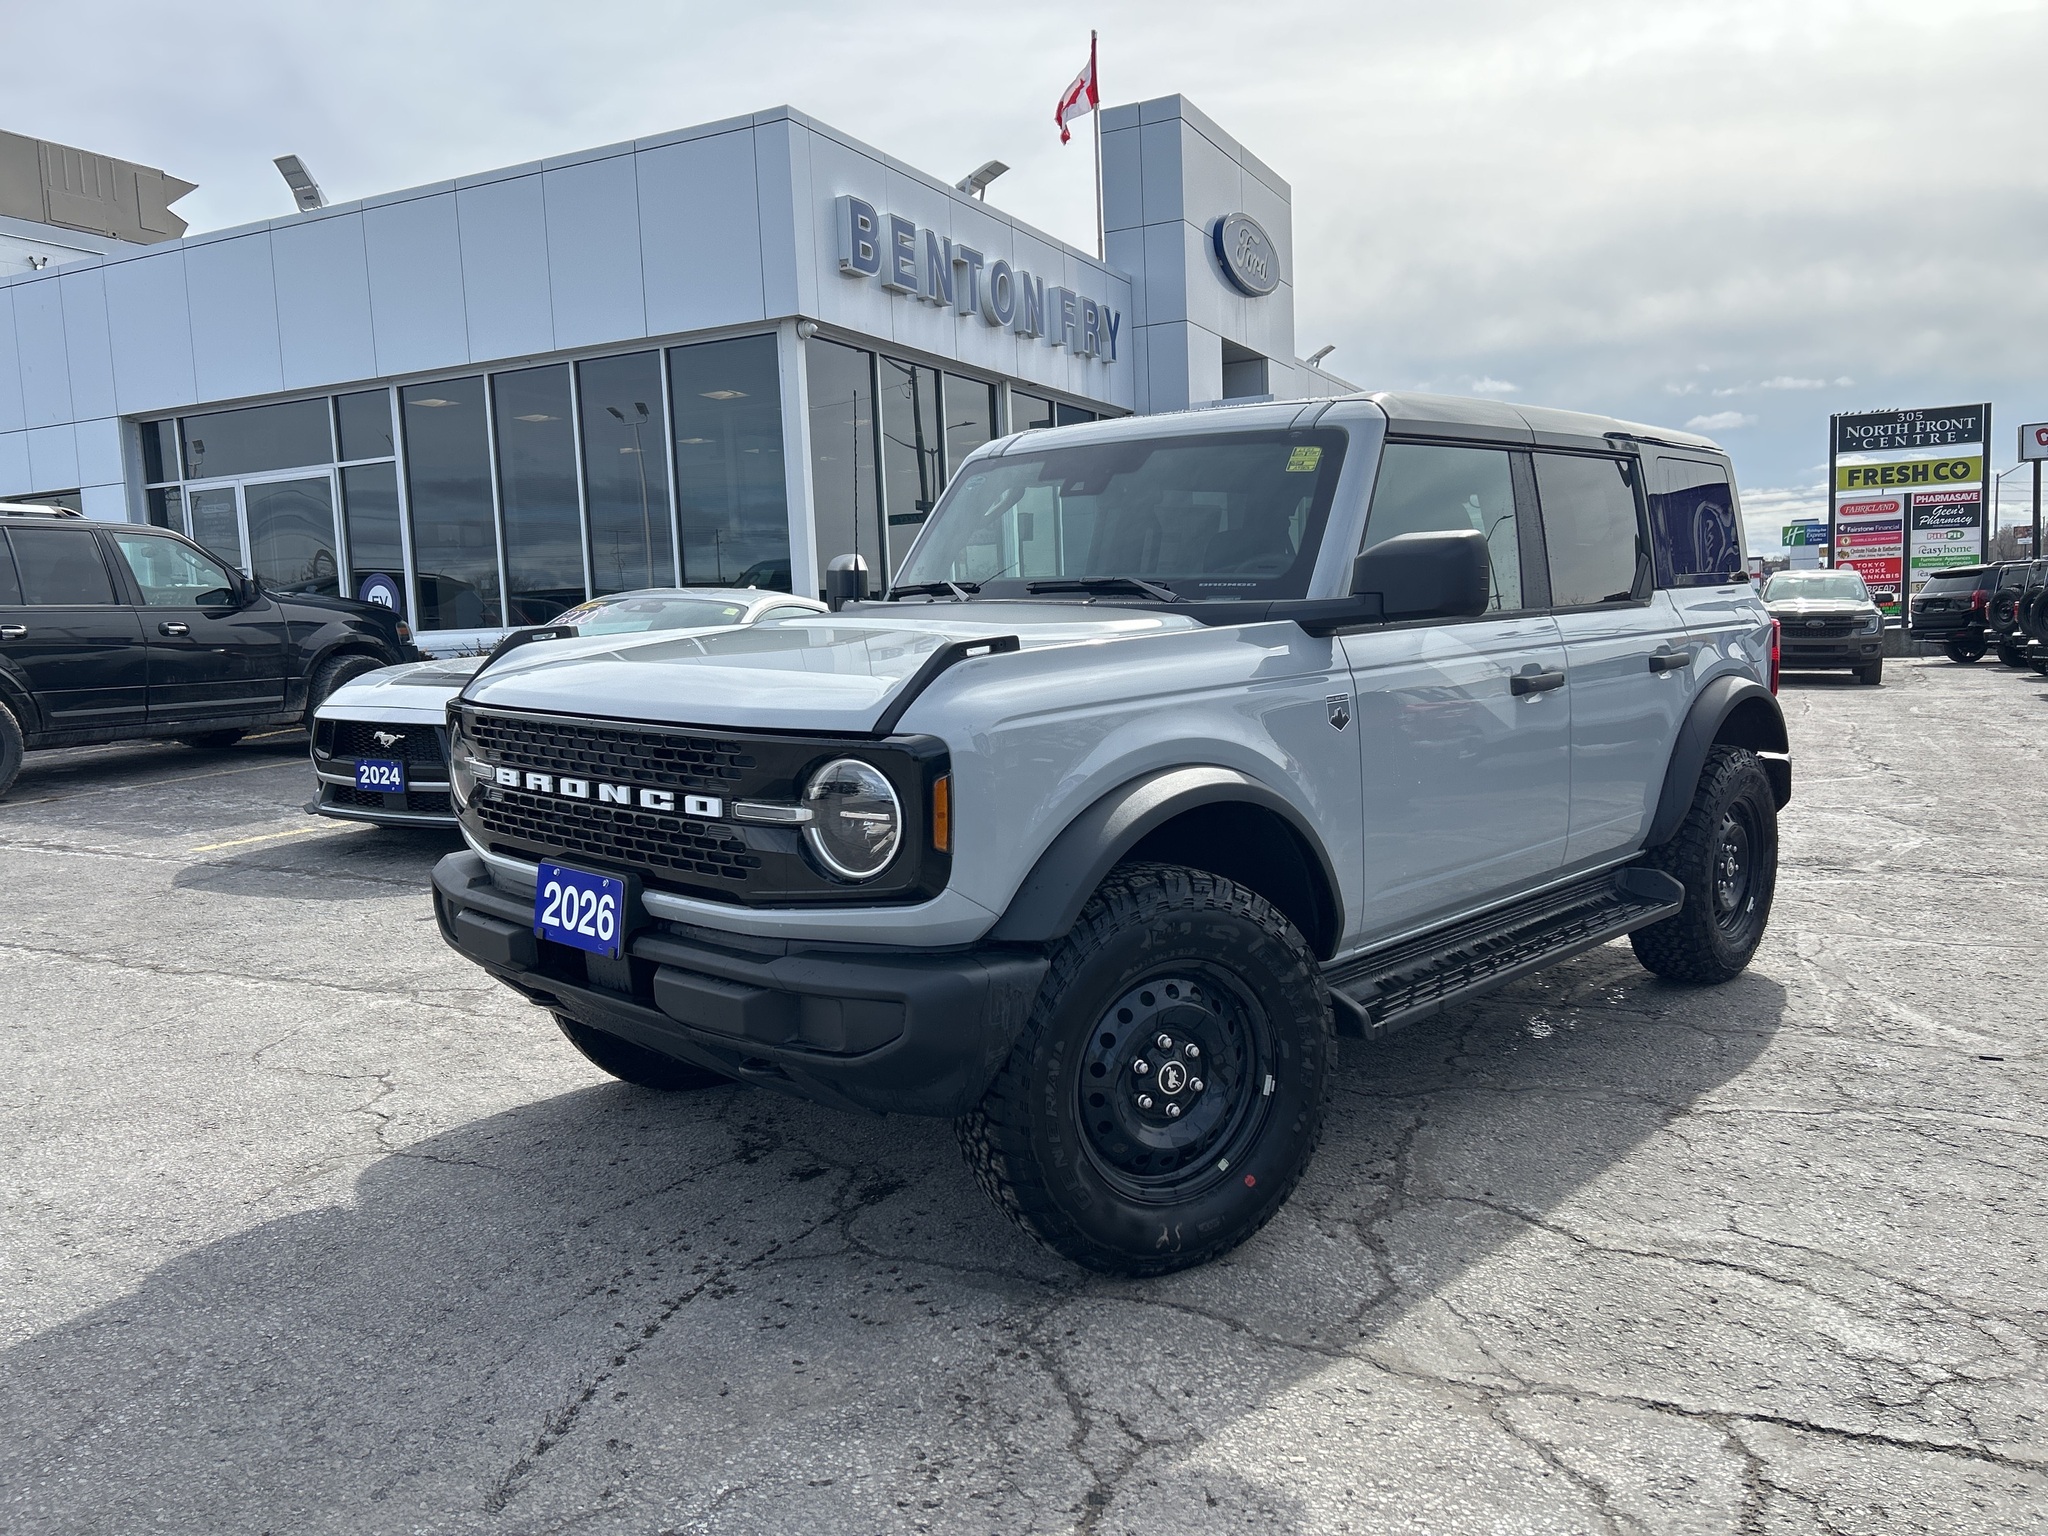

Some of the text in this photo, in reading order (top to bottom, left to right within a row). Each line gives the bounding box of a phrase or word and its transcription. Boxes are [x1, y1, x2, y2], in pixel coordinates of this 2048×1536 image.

[1235, 225, 1269, 281] Ford
[837, 195, 1121, 363] BENTON FRY
[1897, 411, 1923, 422] 305
[1846, 417, 1976, 439] NORTH FRONT
[1862, 431, 1956, 449] CENTRE
[1847, 464, 1929, 487] FRESH
[1916, 492, 1978, 503] PHARMASAVE
[1844, 503, 1895, 513] FABRICLAND
[1932, 505, 1964, 518] Geen's
[1847, 523, 1900, 533] Fairstone Financial
[1919, 515, 1973, 527] Pharmacy
[1919, 544, 1972, 556] easyhome
[359, 765, 401, 785] 2024
[496, 767, 723, 818] BRONCO
[541, 881, 615, 941] 2026
[1044, 1040, 1094, 1211] GENERAL
